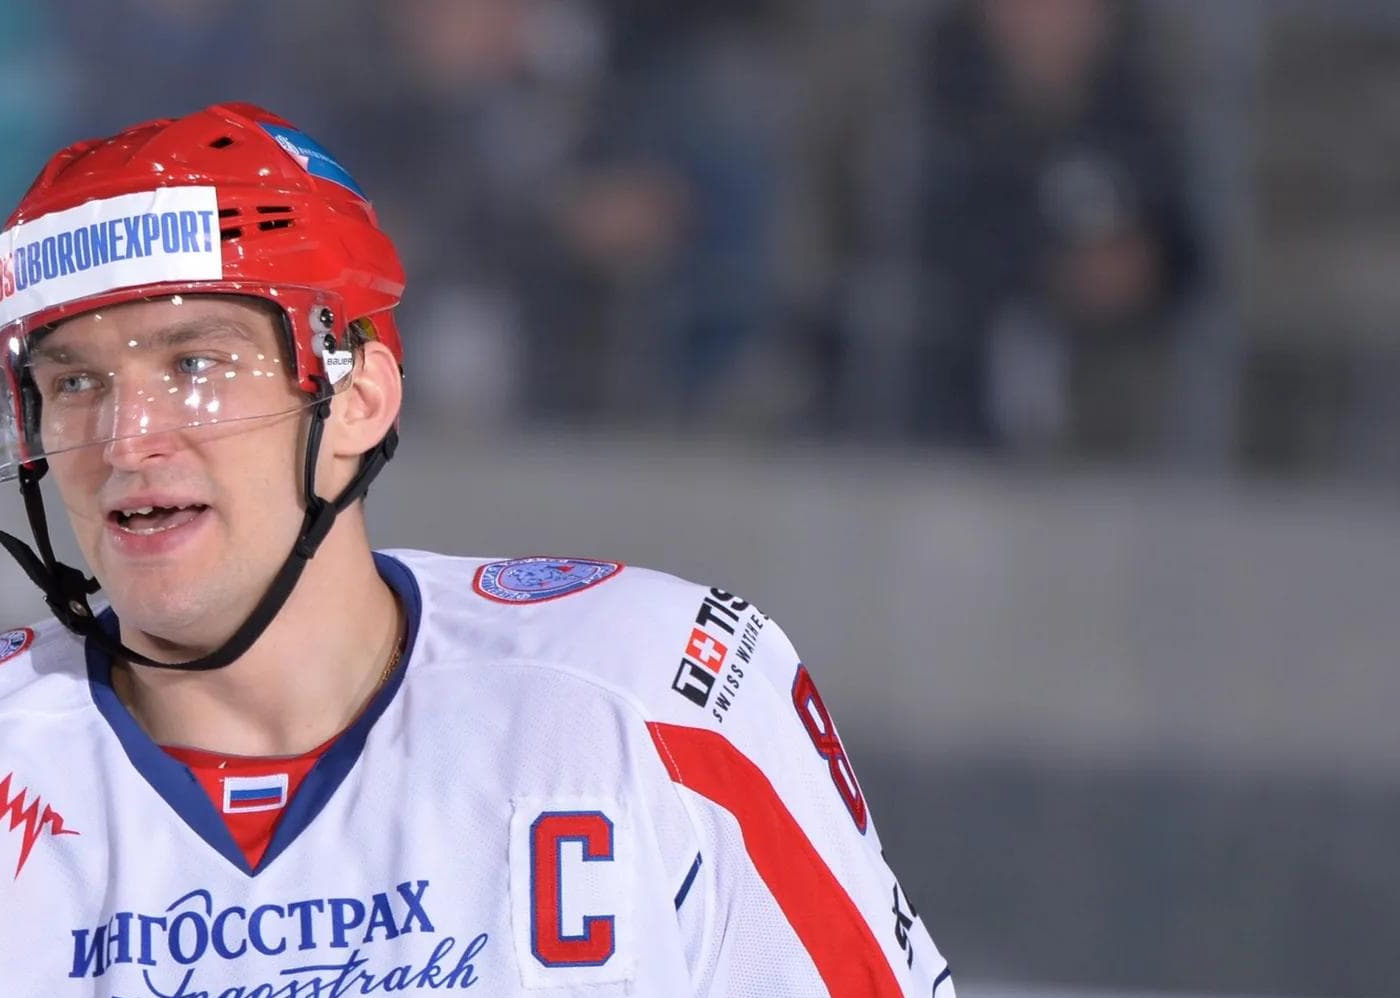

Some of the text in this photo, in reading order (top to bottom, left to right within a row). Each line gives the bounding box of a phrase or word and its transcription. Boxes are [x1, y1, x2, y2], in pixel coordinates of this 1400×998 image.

[712, 612, 769, 723] SWISS WATCHE
[68, 879, 435, 978] ИНГОССТРАХ
